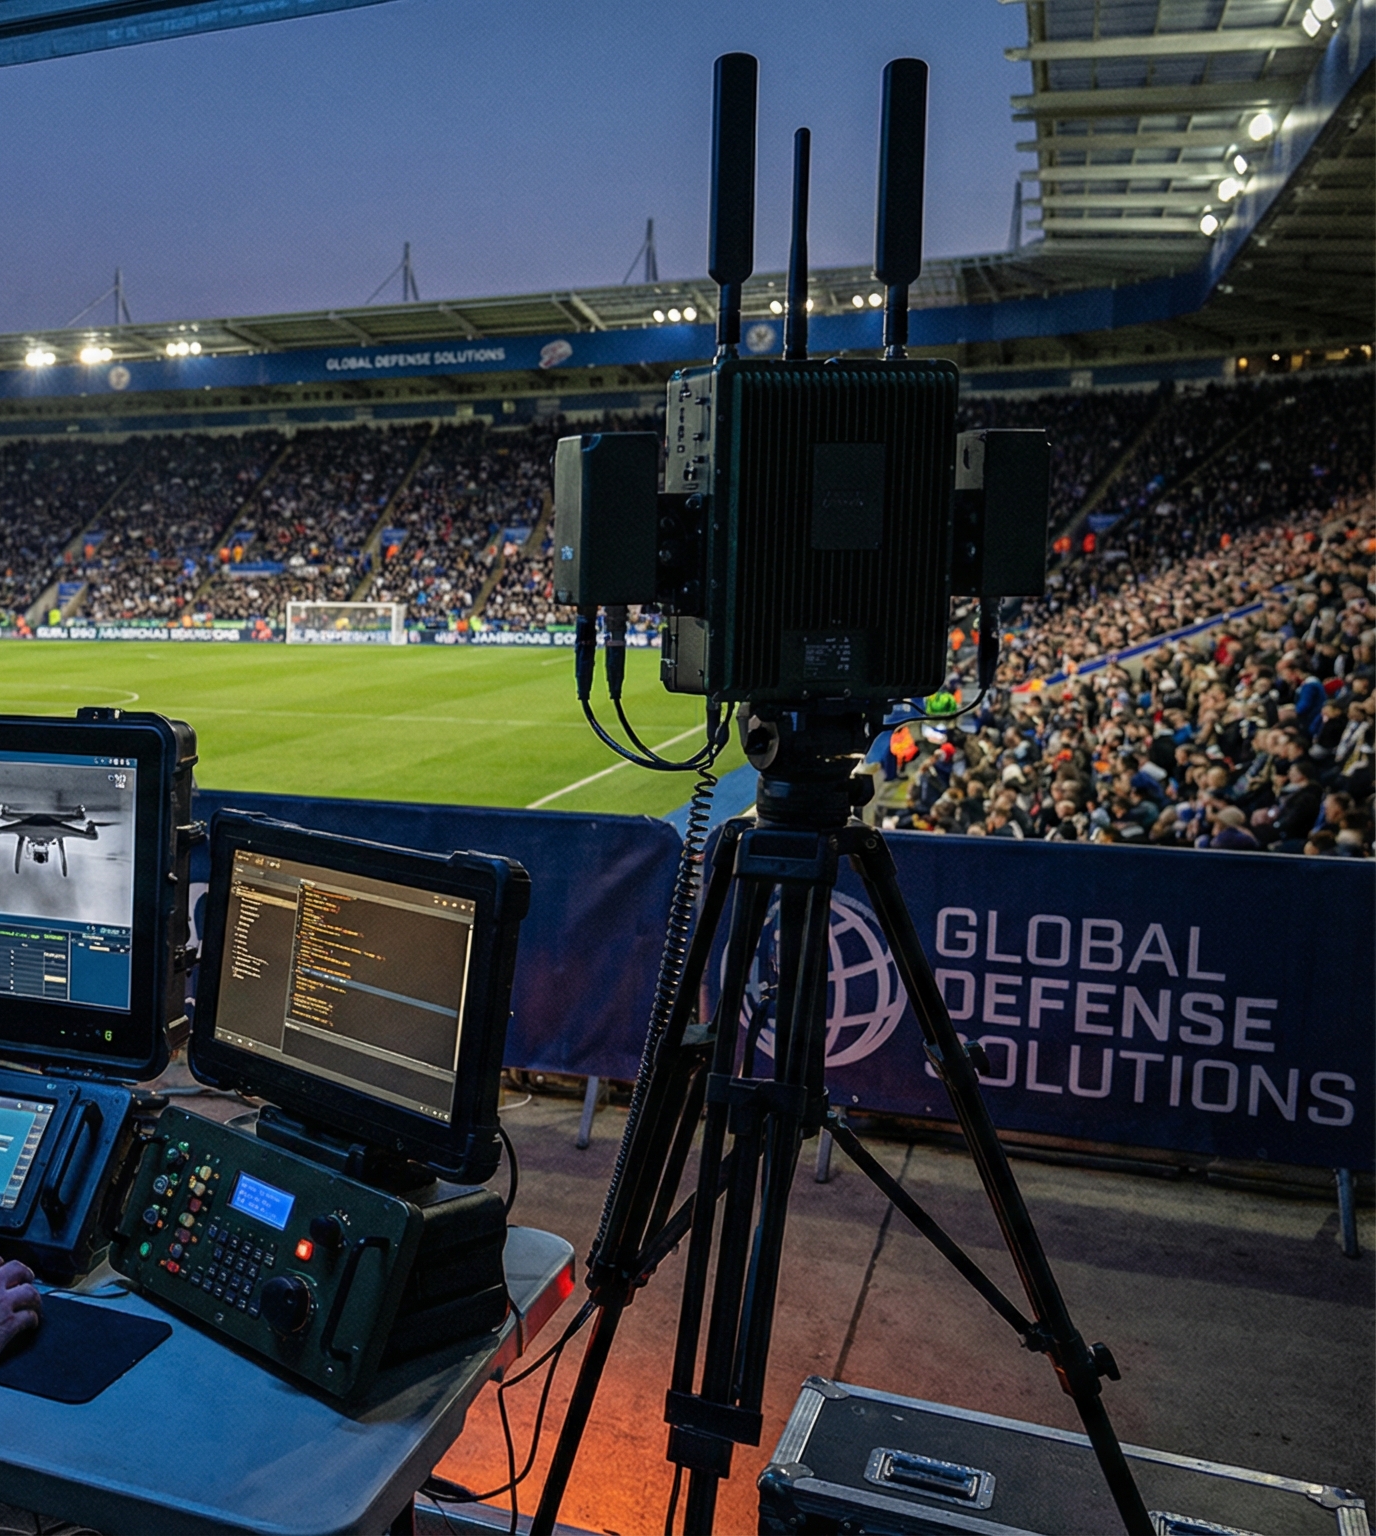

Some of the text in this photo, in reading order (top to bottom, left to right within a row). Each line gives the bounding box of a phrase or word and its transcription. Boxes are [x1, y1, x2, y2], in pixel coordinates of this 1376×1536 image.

[326, 348, 506, 370] GLOBAL DEFENSE SOLUTIONS
[935, 907, 1226, 982] GLOBAL
[935, 968, 1278, 1052] DEFENSE
